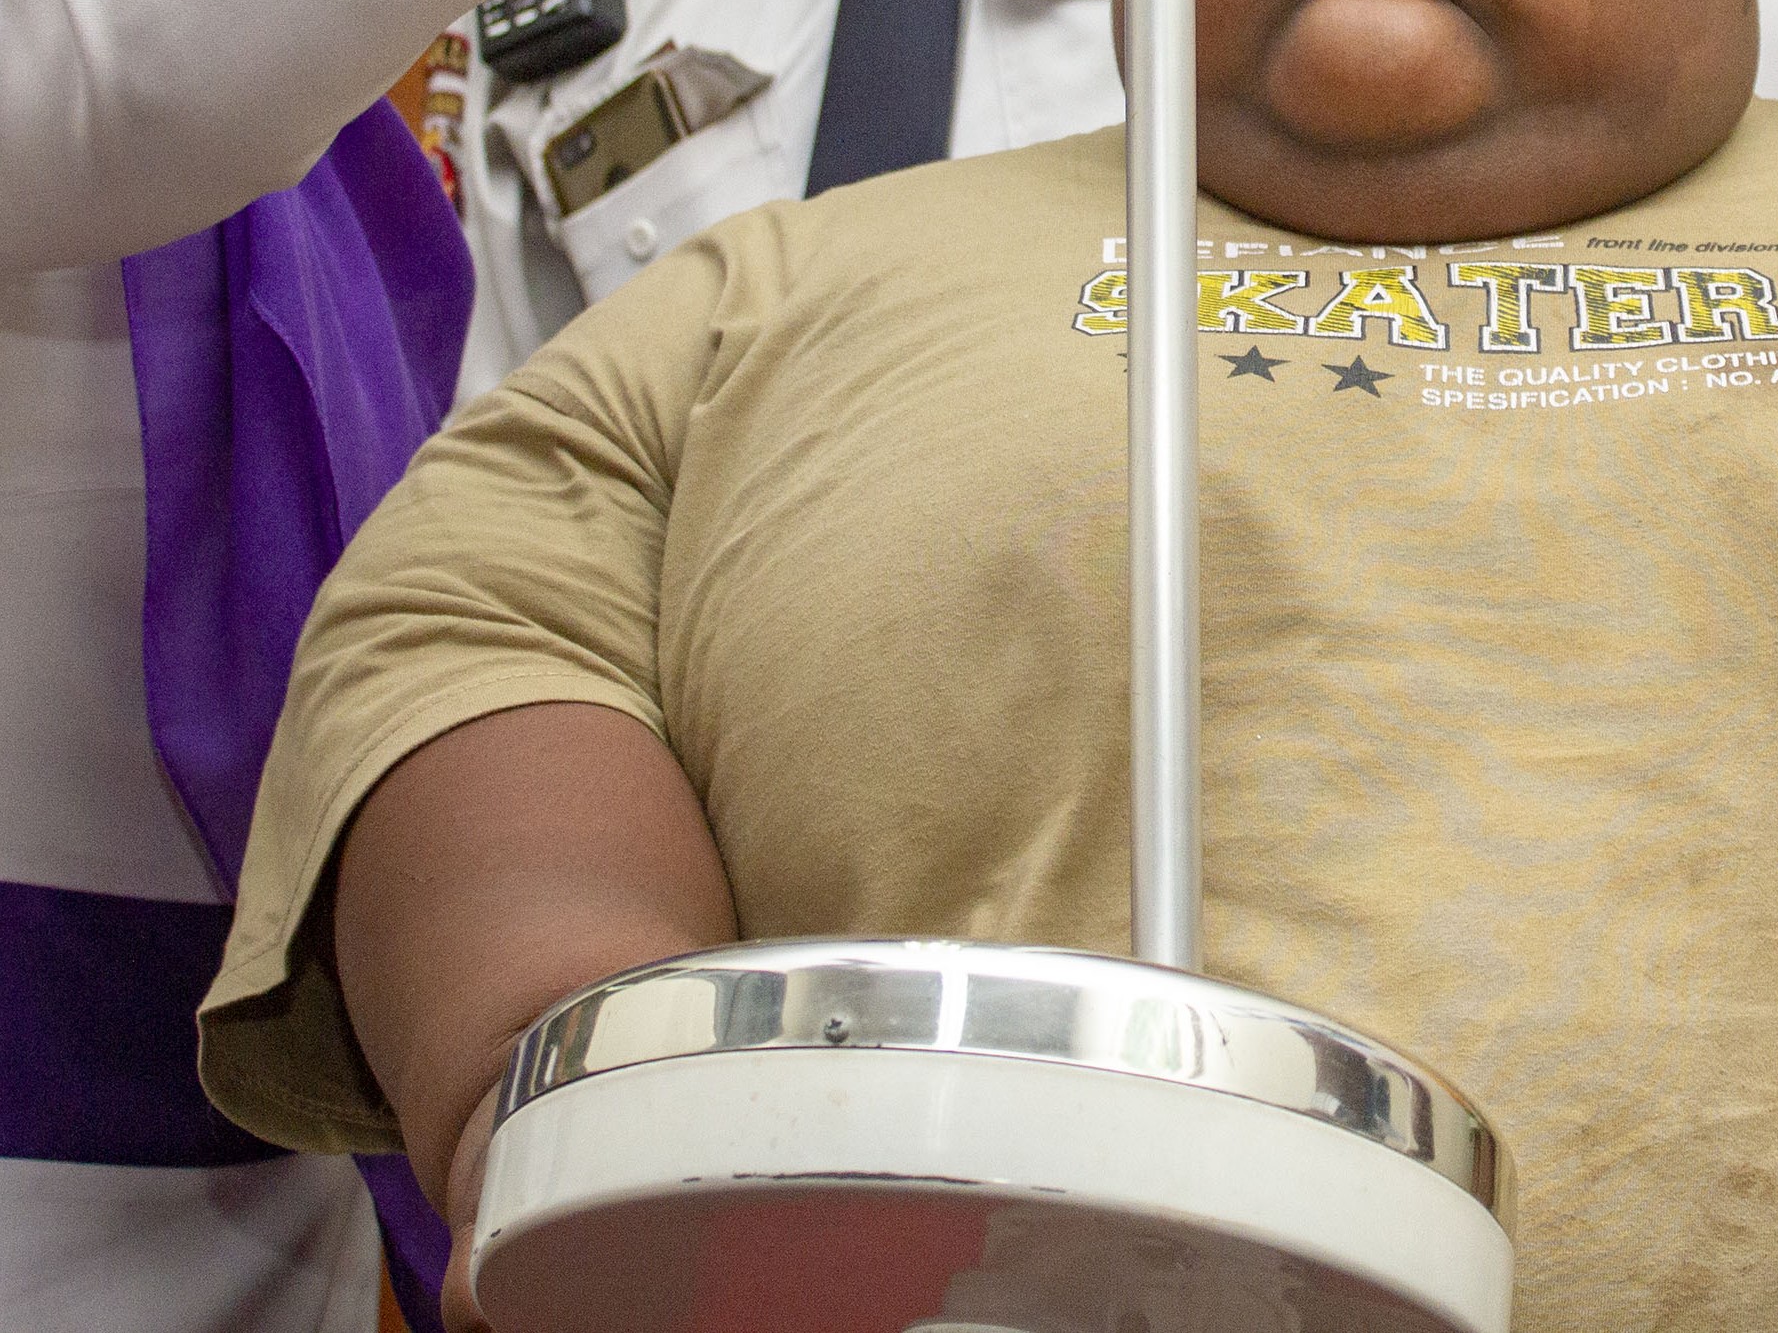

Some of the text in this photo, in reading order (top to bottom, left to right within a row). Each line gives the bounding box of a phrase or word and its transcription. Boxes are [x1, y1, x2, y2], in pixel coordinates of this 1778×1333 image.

[1586, 236, 1642, 251] front
[1648, 238, 1689, 253] line
[1420, 363, 1487, 388] THE
[1498, 359, 1645, 387] QUALITY
[1421, 377, 1671, 411] SPESIFICATION
[1705, 370, 1763, 389] NO.
